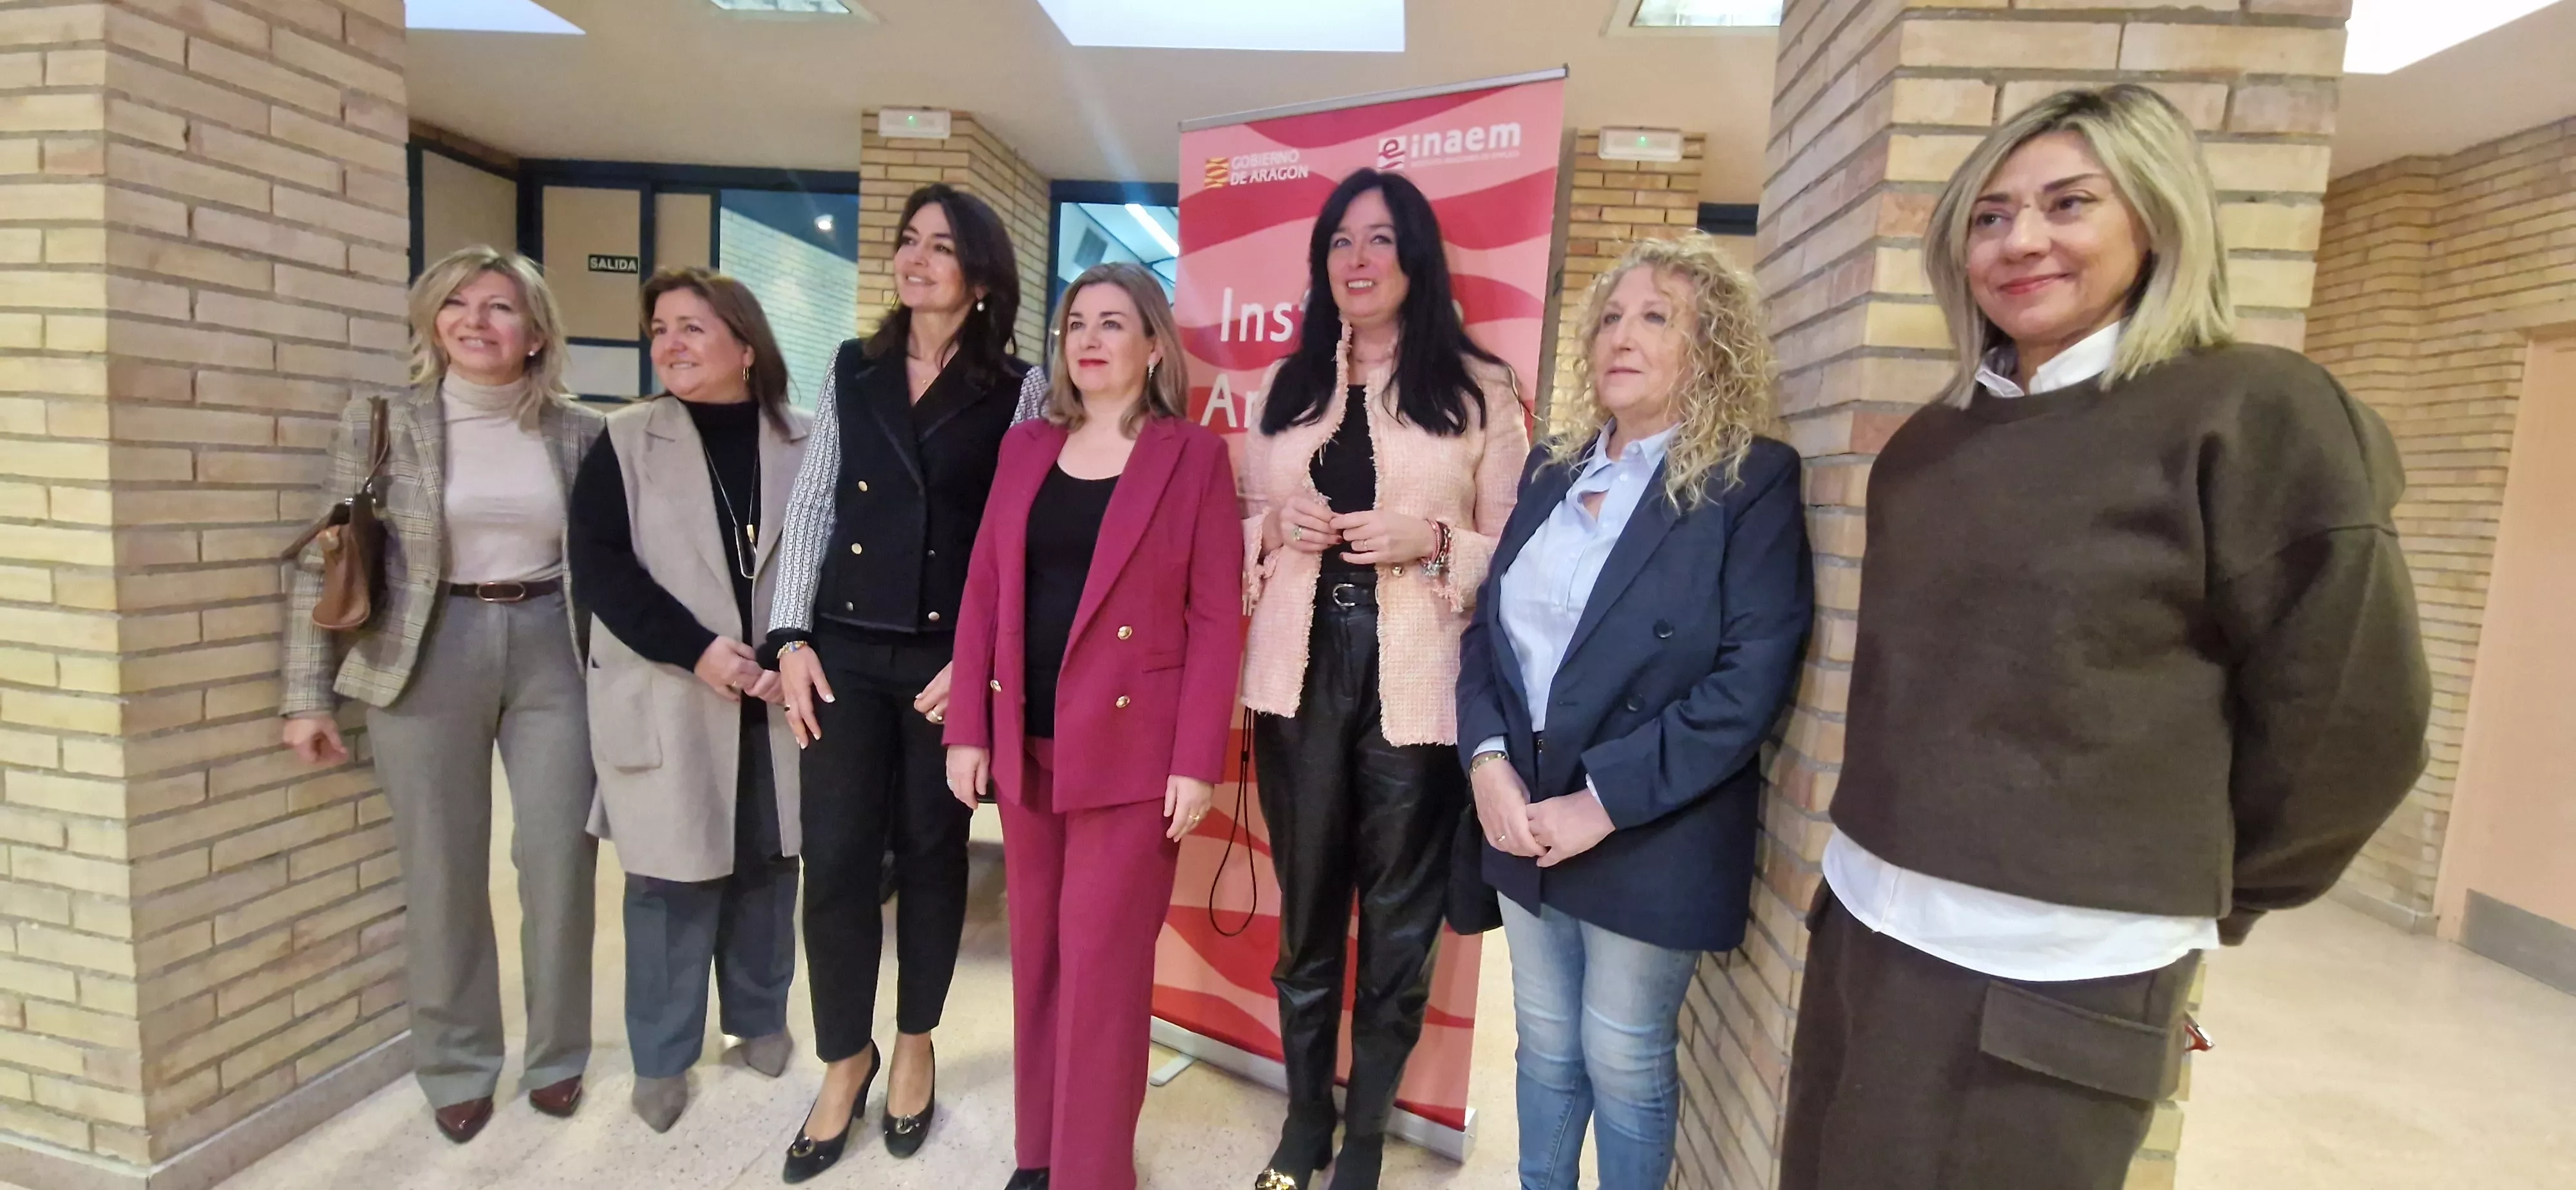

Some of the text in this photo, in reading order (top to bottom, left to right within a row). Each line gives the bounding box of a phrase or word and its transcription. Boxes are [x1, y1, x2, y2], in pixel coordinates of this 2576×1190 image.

[1410, 121, 1521, 158] inaem
[1231, 149, 1300, 170] GOBIERNO
[1229, 172, 1248, 186] DE
[589, 257, 638, 271] SALIDA
